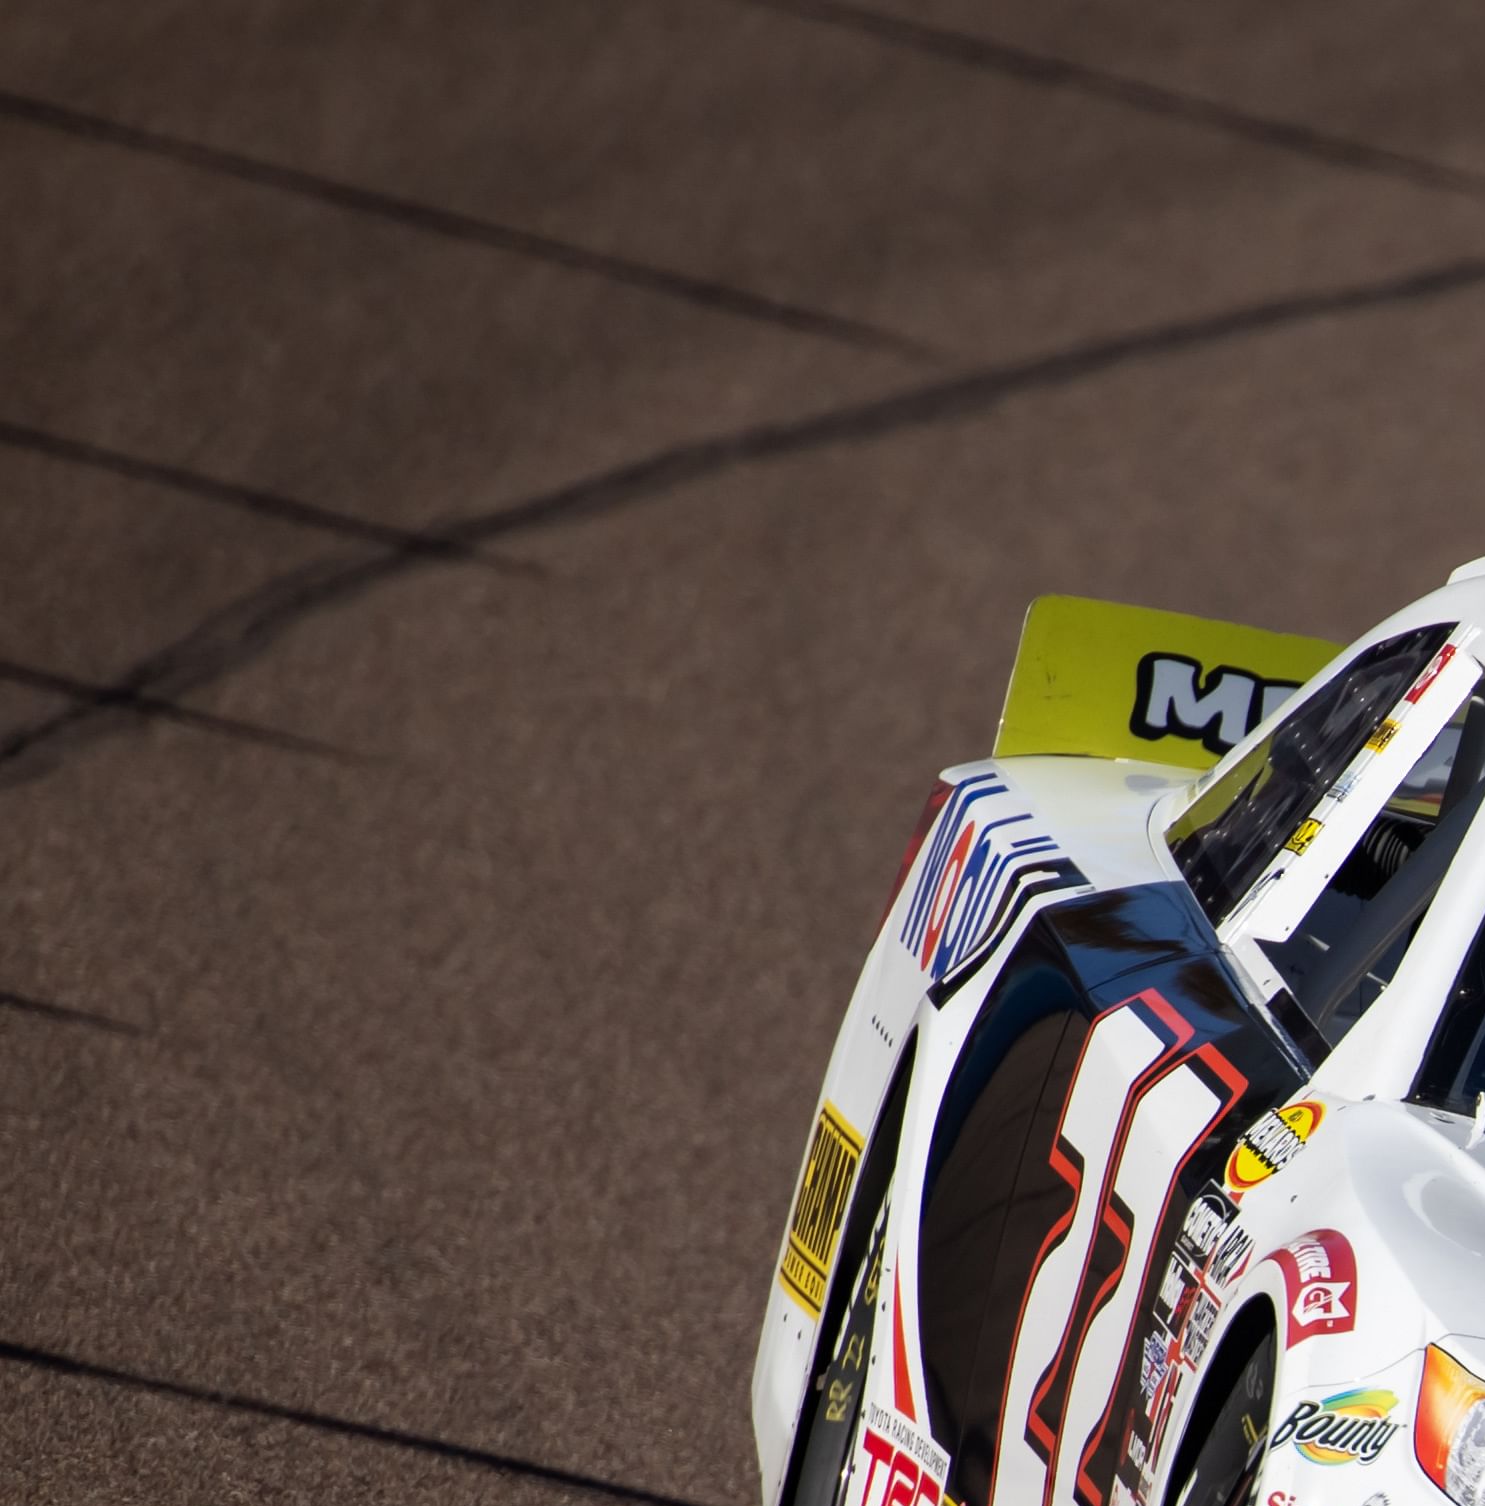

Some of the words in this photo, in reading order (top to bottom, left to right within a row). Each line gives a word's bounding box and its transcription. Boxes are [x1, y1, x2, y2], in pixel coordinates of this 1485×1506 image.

[1239, 1107, 1306, 1174] MENARDS
[792, 1118, 858, 1267] CHAMP
[1268, 1399, 1404, 1465] Bounty
